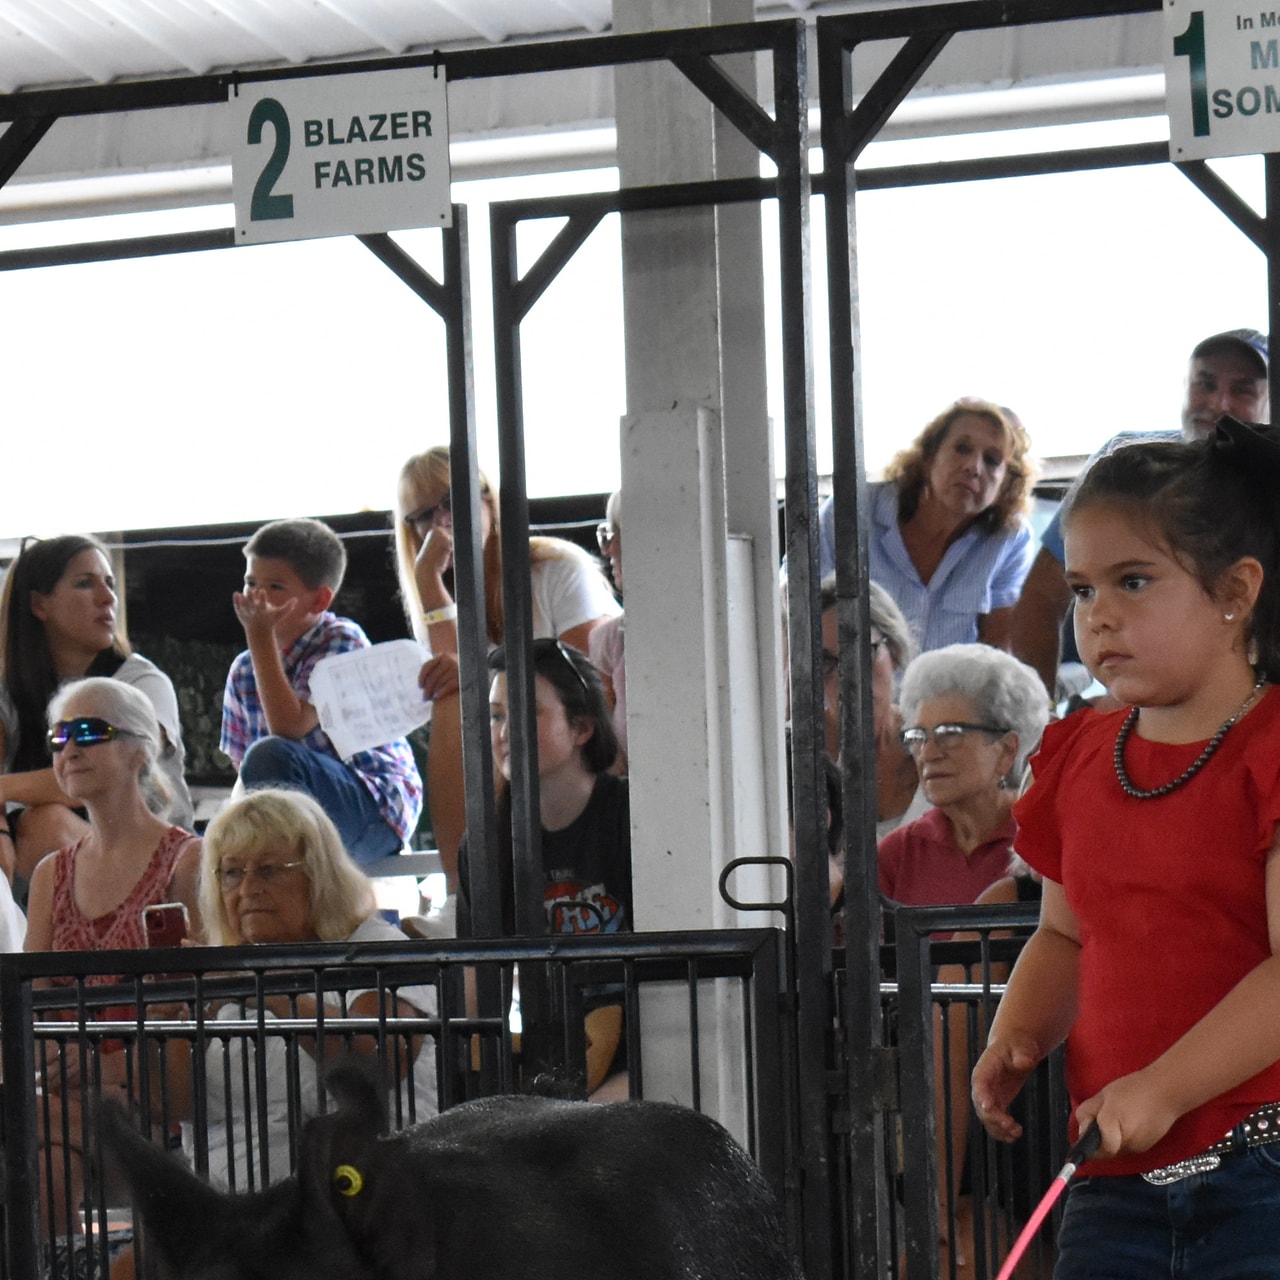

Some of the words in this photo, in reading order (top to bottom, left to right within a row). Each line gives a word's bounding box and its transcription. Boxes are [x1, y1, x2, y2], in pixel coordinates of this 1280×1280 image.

[1236, 15, 1254, 30] In
[1173, 10, 1210, 137] 1
[304, 110, 432, 147] BLAZER
[247, 97, 294, 221] 2
[314, 153, 426, 189] FARMS
